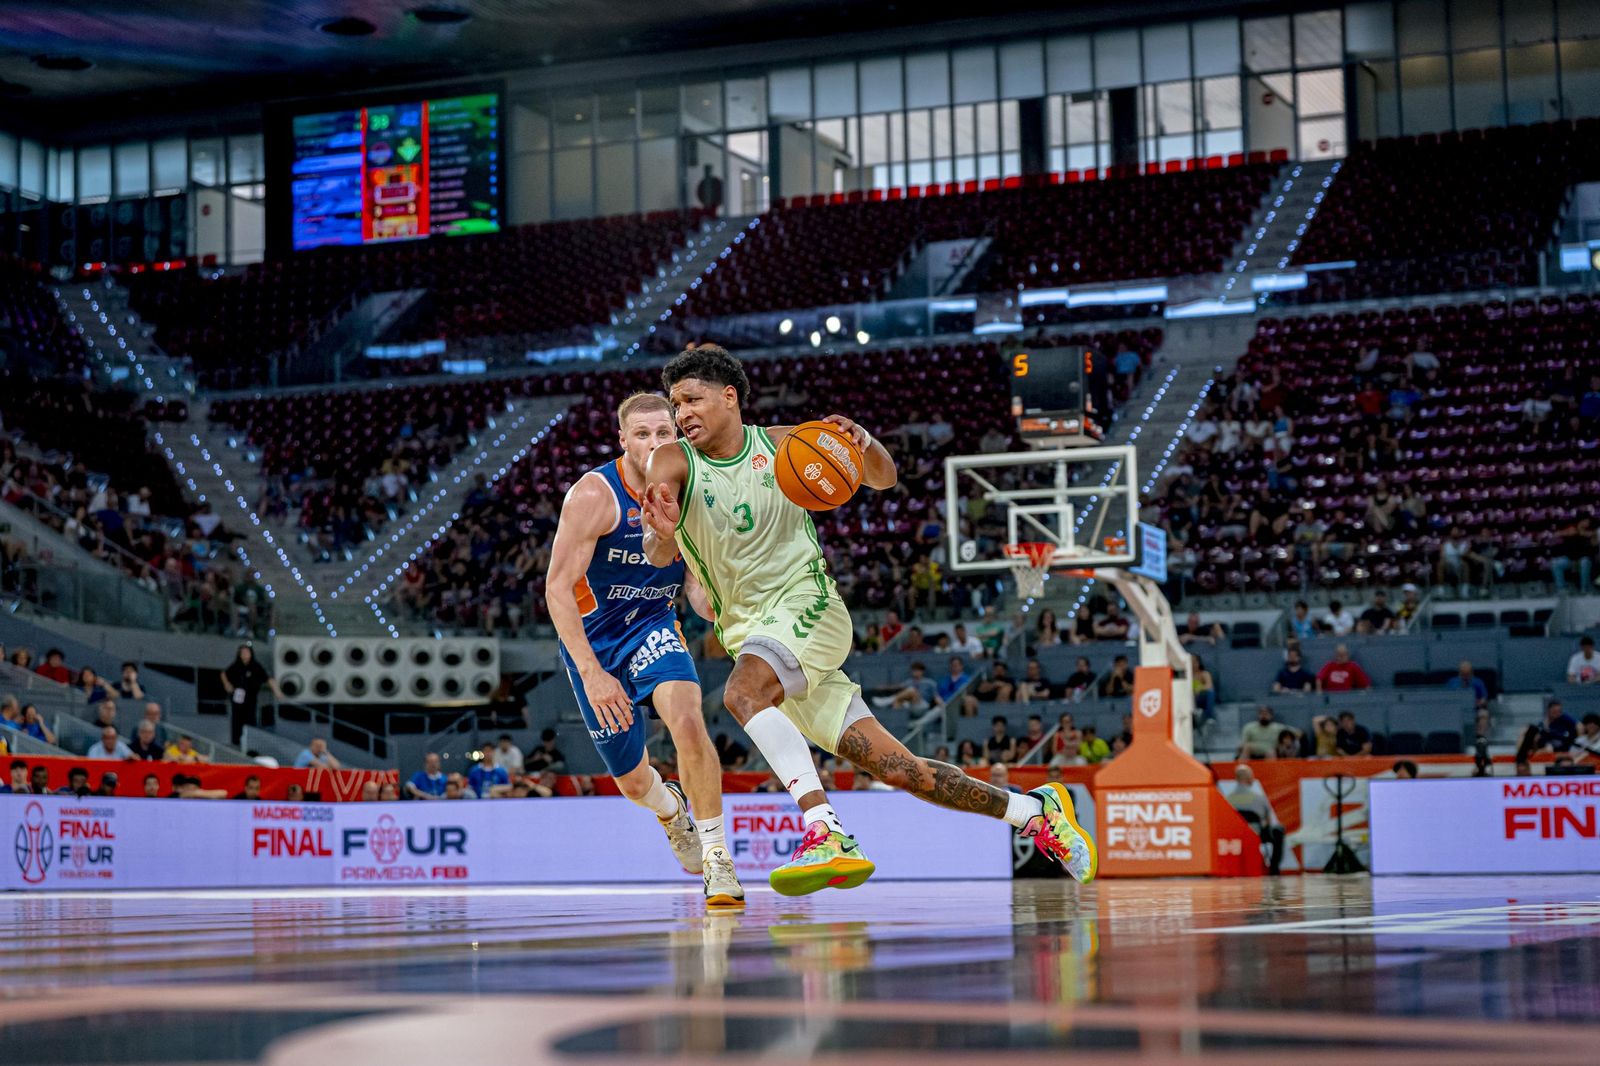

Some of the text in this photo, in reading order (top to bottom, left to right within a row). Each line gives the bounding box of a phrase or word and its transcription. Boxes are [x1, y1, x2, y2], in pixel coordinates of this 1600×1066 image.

[816, 431, 859, 484] Wilson
[733, 503, 754, 532] 3
[1106, 804, 1193, 822] FINAL
[60, 821, 115, 838] FINAL
[253, 828, 333, 857] FINAL
[342, 866, 468, 880] PRIMERA FEB
